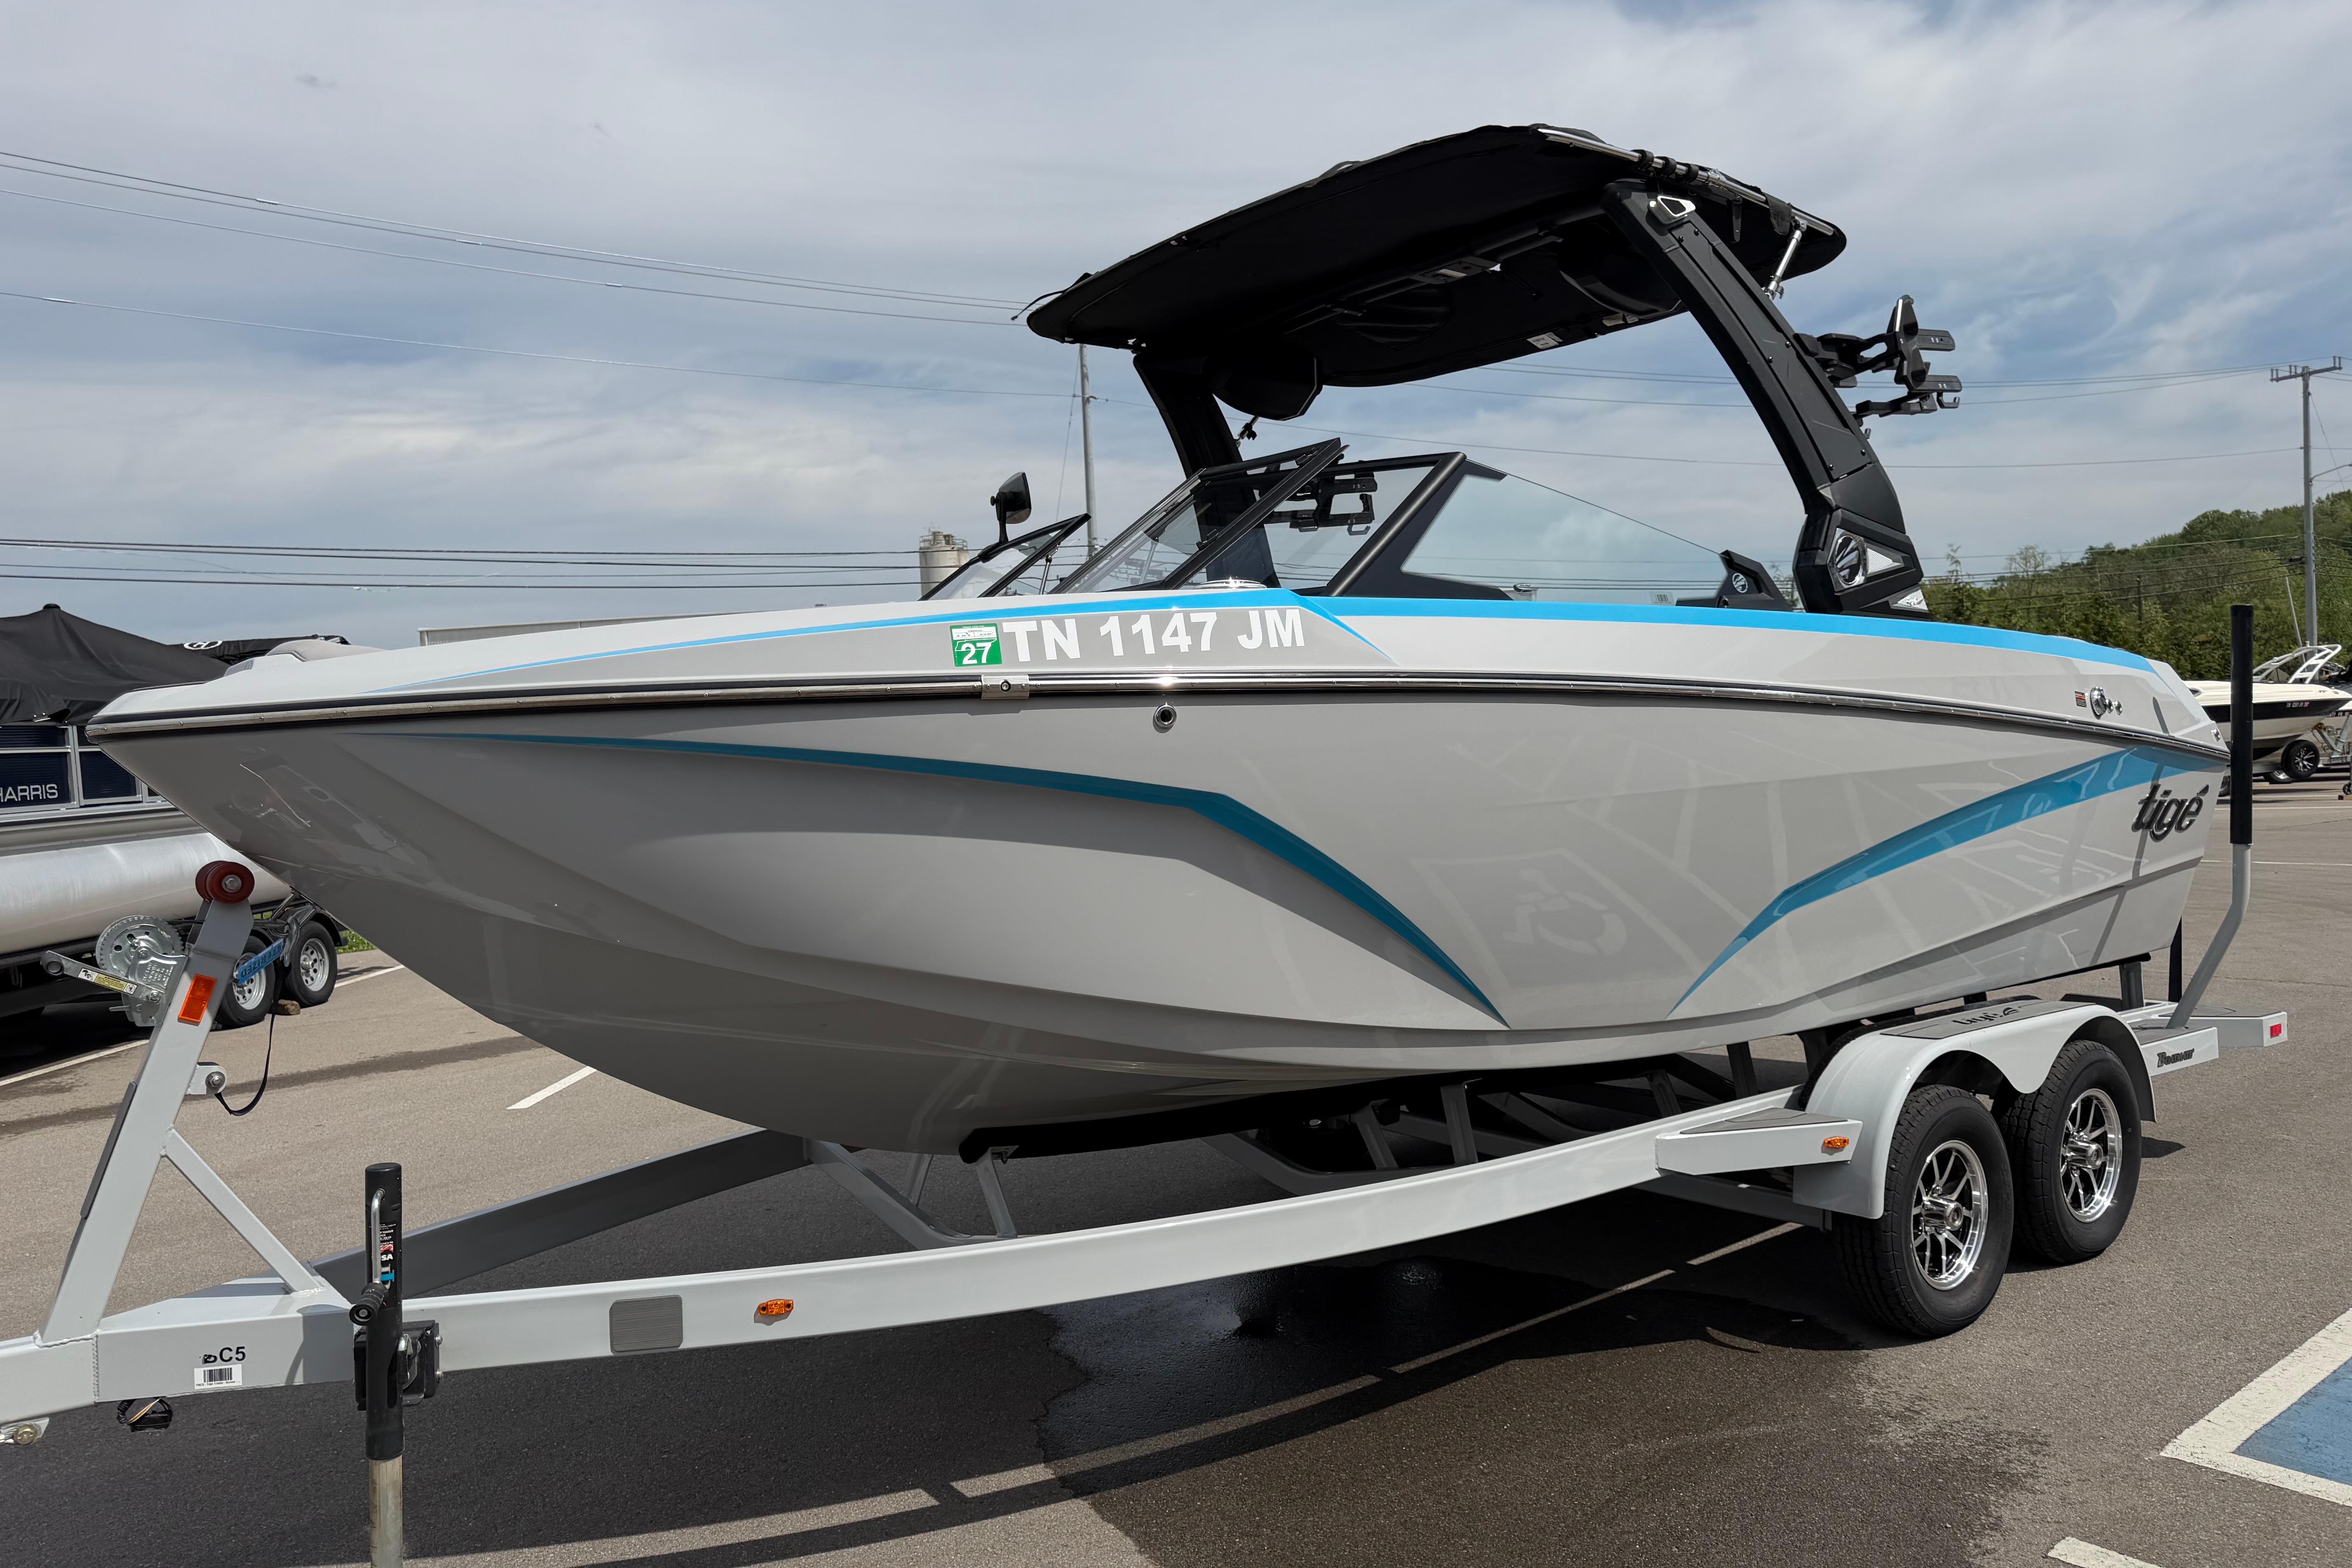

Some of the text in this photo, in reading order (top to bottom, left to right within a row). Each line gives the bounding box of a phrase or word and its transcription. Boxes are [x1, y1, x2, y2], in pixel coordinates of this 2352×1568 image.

[1002, 609, 1305, 661] TN 1147 JM
[961, 642, 992, 665] 27
[0, 784, 58, 802] ARRIS
